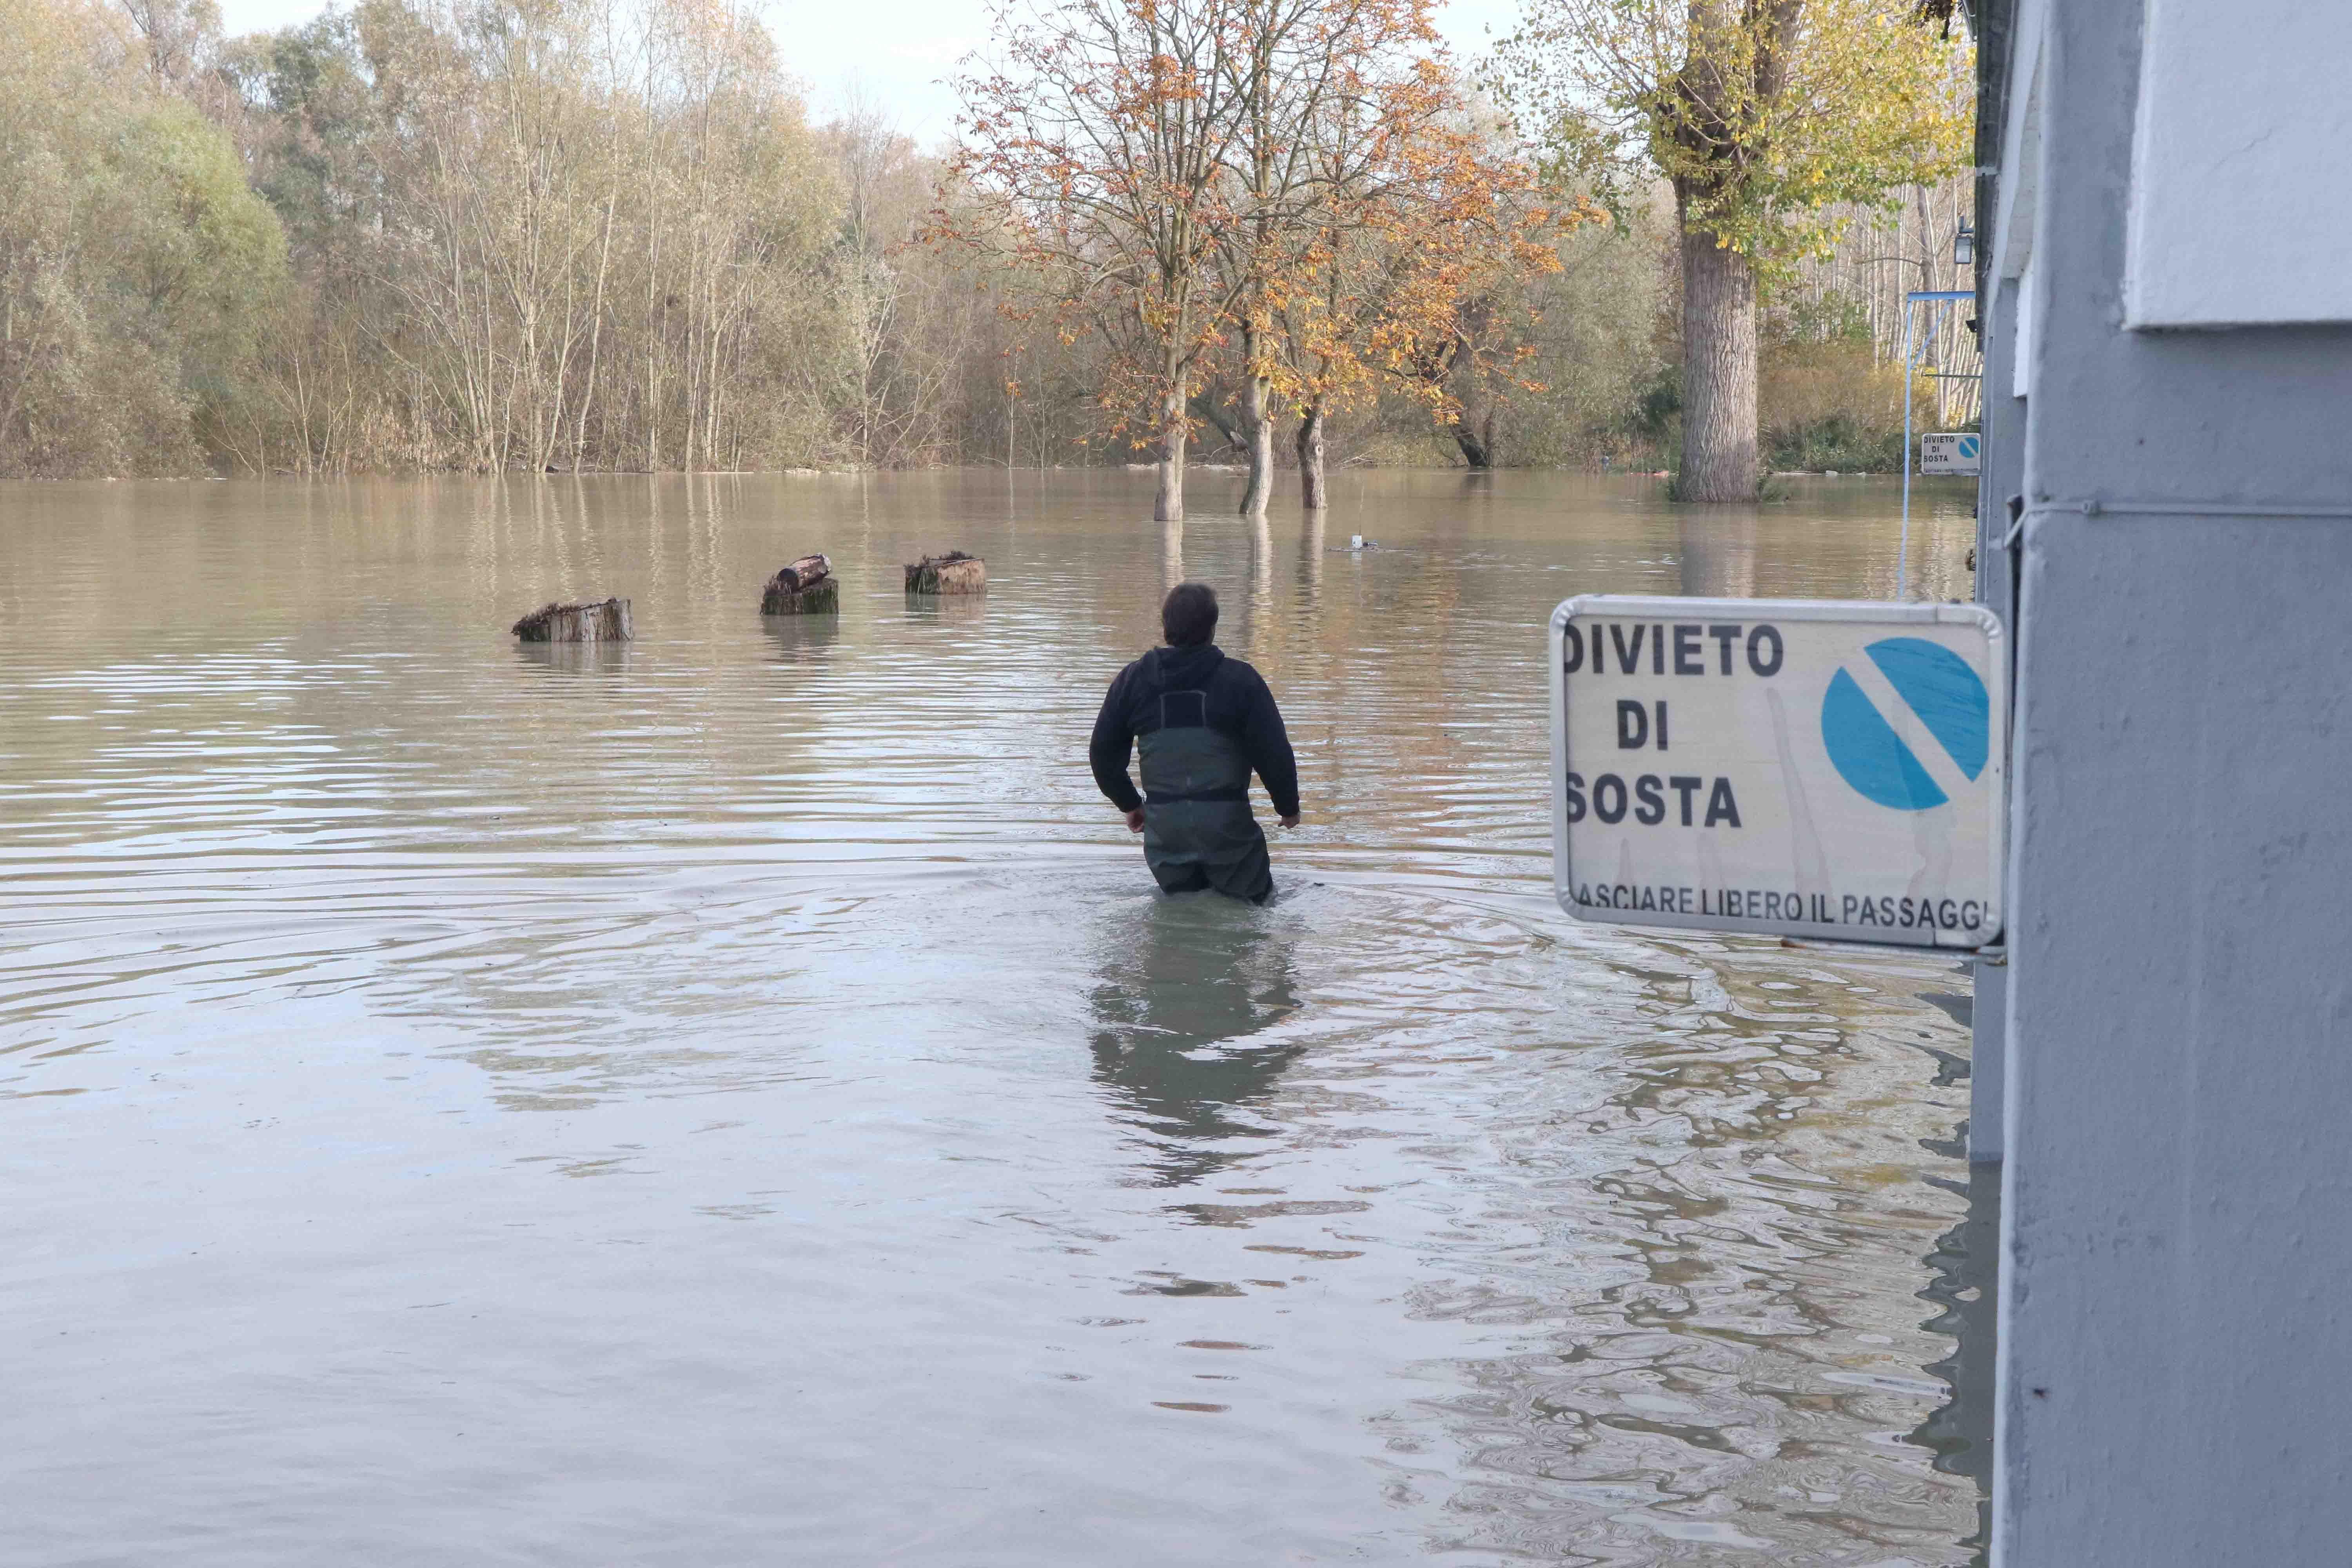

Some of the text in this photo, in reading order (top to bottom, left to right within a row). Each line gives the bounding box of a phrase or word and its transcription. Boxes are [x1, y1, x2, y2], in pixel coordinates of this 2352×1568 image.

[1564, 624, 1784, 677] DIVIETO
[1616, 699, 1669, 750] DI
[1566, 772, 1742, 828] SOSTA
[1702, 888, 1803, 922] LIBERO
[1811, 893, 1835, 923] IL
[1842, 895, 1988, 931] PASSAGG
